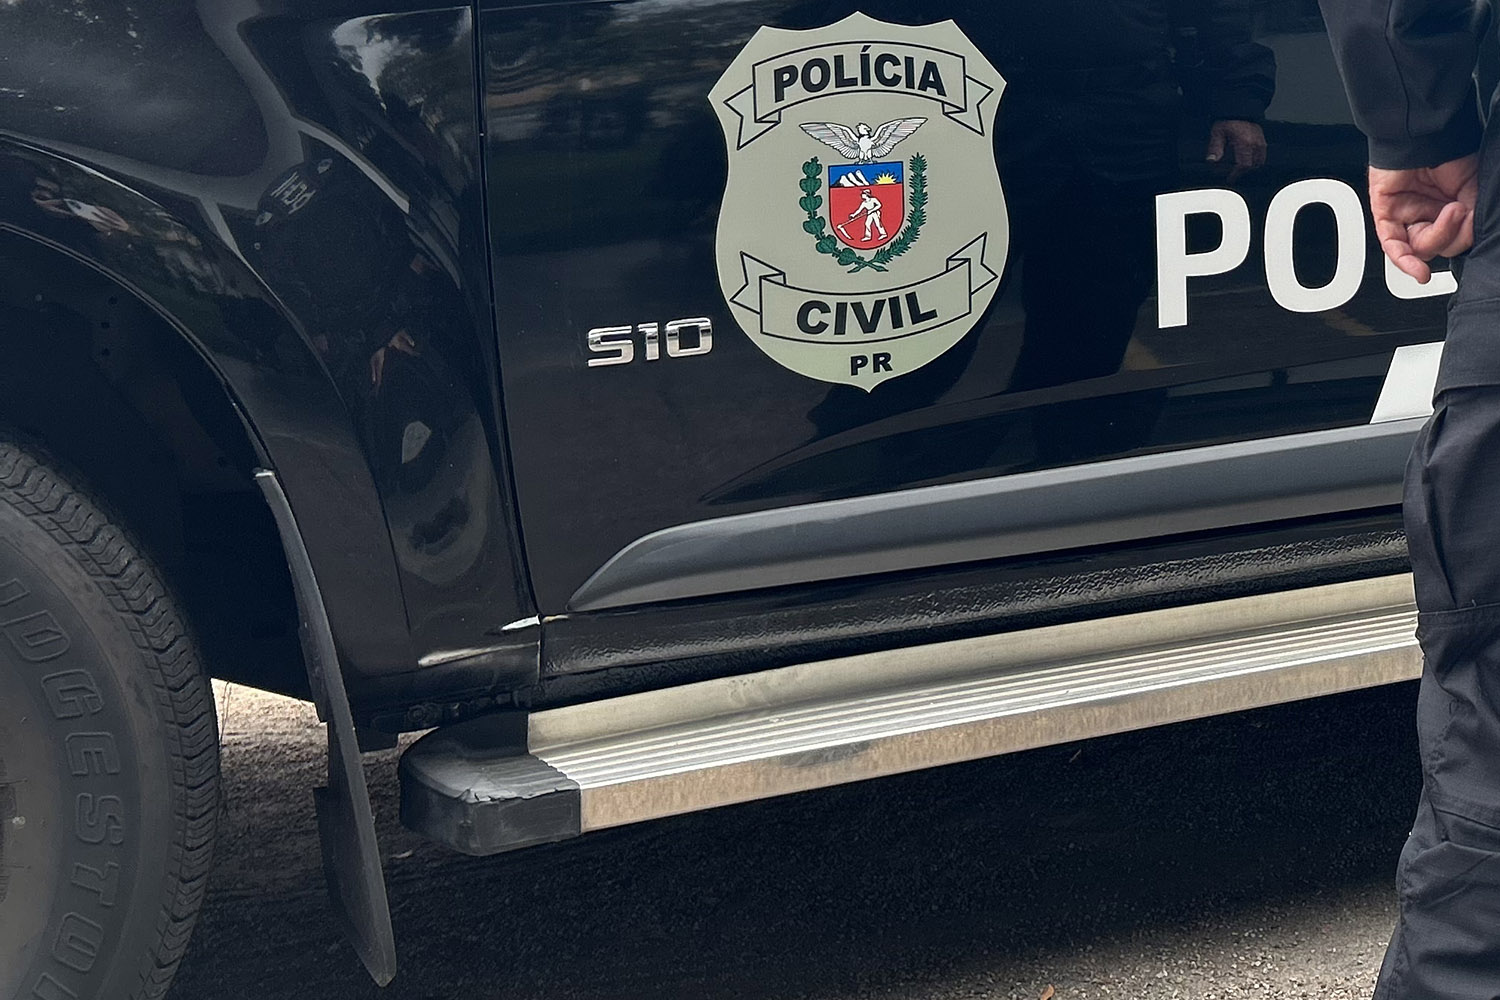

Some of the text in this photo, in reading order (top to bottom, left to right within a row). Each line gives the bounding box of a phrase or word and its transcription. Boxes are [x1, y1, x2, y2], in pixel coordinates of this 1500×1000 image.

[774, 45, 947, 103] POLÍCIA
[796, 292, 938, 336] CIVIL
[587, 316, 713, 367] S10
[850, 352, 893, 376] PR
